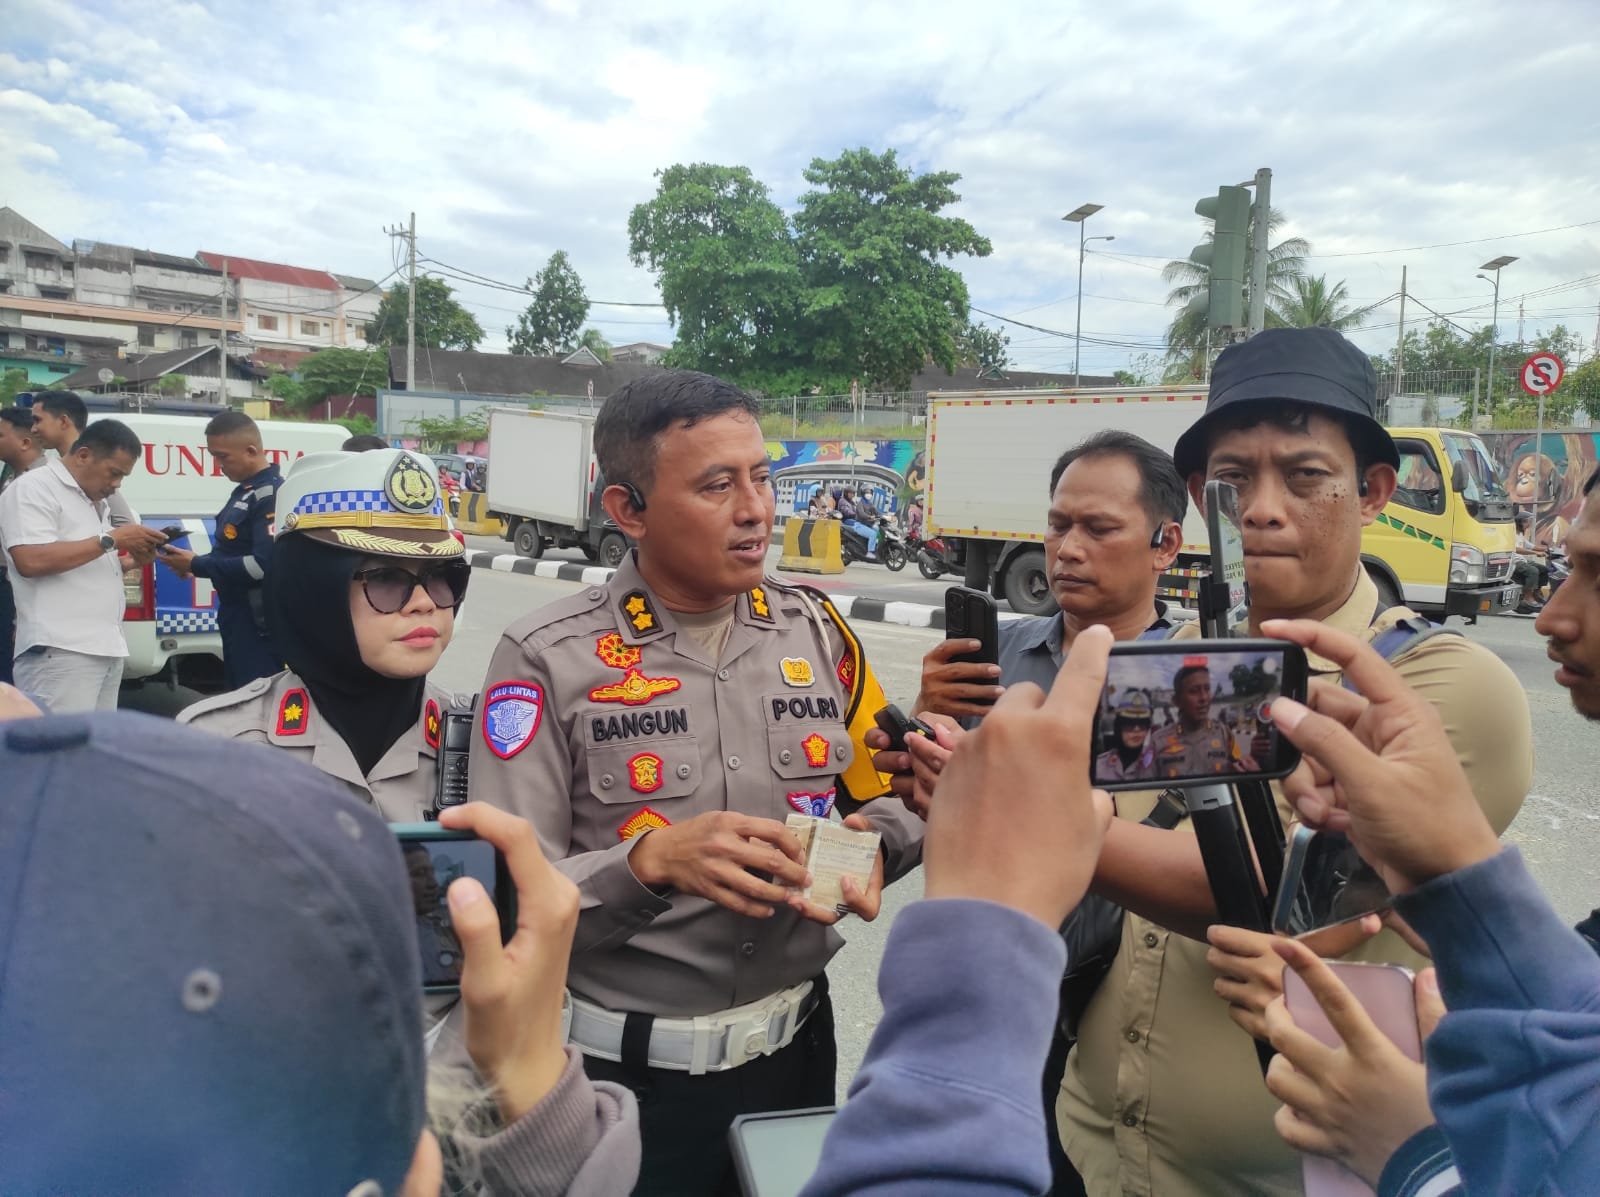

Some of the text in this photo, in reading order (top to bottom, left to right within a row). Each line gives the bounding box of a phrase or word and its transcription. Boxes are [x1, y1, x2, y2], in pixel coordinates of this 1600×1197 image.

[490, 686, 537, 699] LALU LINTAS
[772, 696, 838, 721] POLRI
[592, 708, 688, 742] BANGUN
